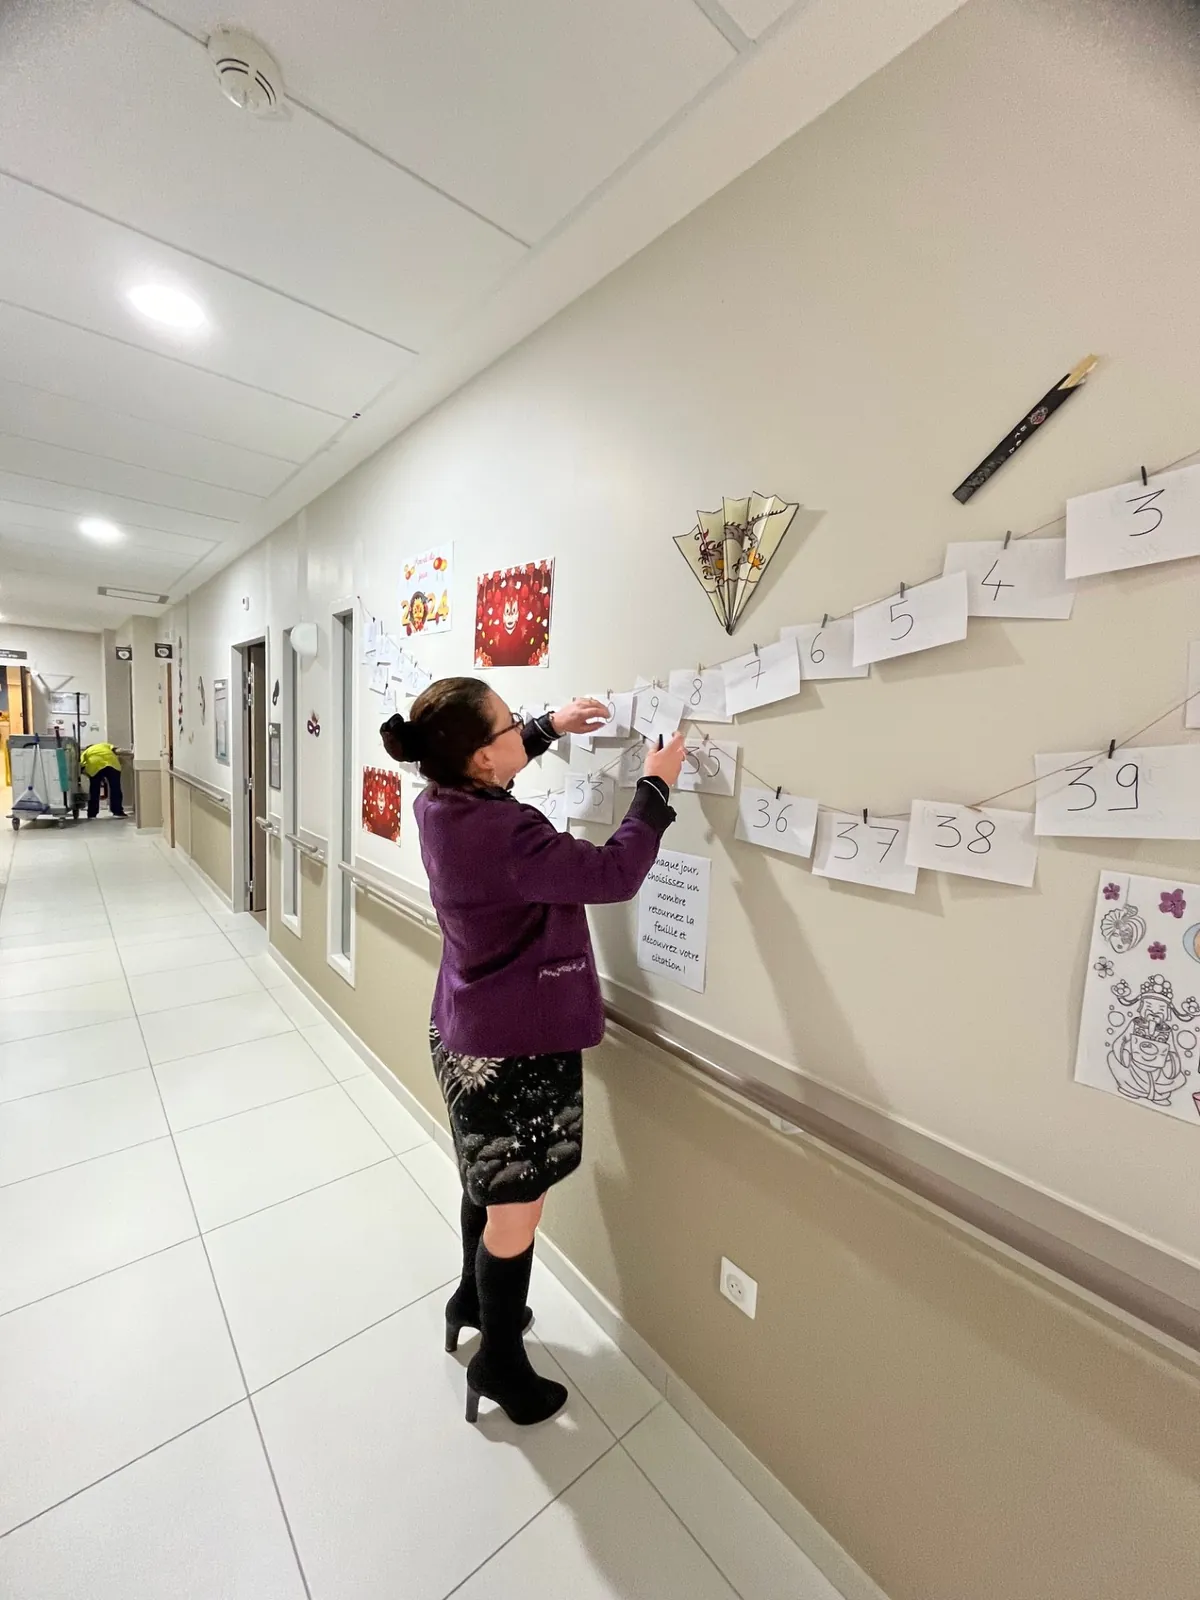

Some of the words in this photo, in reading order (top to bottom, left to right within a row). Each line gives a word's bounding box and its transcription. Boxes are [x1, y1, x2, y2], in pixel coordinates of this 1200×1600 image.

[1125, 488, 1166, 537] 3
[980, 559, 1015, 602] 4
[889, 599, 914, 642] 5
[810, 632, 826, 665] 6
[743, 659, 767, 690] 7
[689, 678, 703, 706] 8
[640, 696, 660, 724] 9
[683, 746, 721, 778] 35
[572, 779, 604, 807] 33
[1064, 763, 1139, 812] 39
[539, 797, 558, 820] 32
[752, 798, 793, 833] 36
[834, 822, 900, 864] 37
[934, 815, 996, 855] 38
[647, 871, 685, 889] choisissez
[686, 883, 700, 892] un
[678, 860, 699, 876] jour,
[657, 892, 686, 907] nombre
[648, 904, 684, 922] retournez
[686, 914, 695, 926] la
[654, 920, 678, 938] feuille
[679, 931, 687, 941] et
[642, 934, 678, 954] découvrez
[679, 949, 700, 962] votre
